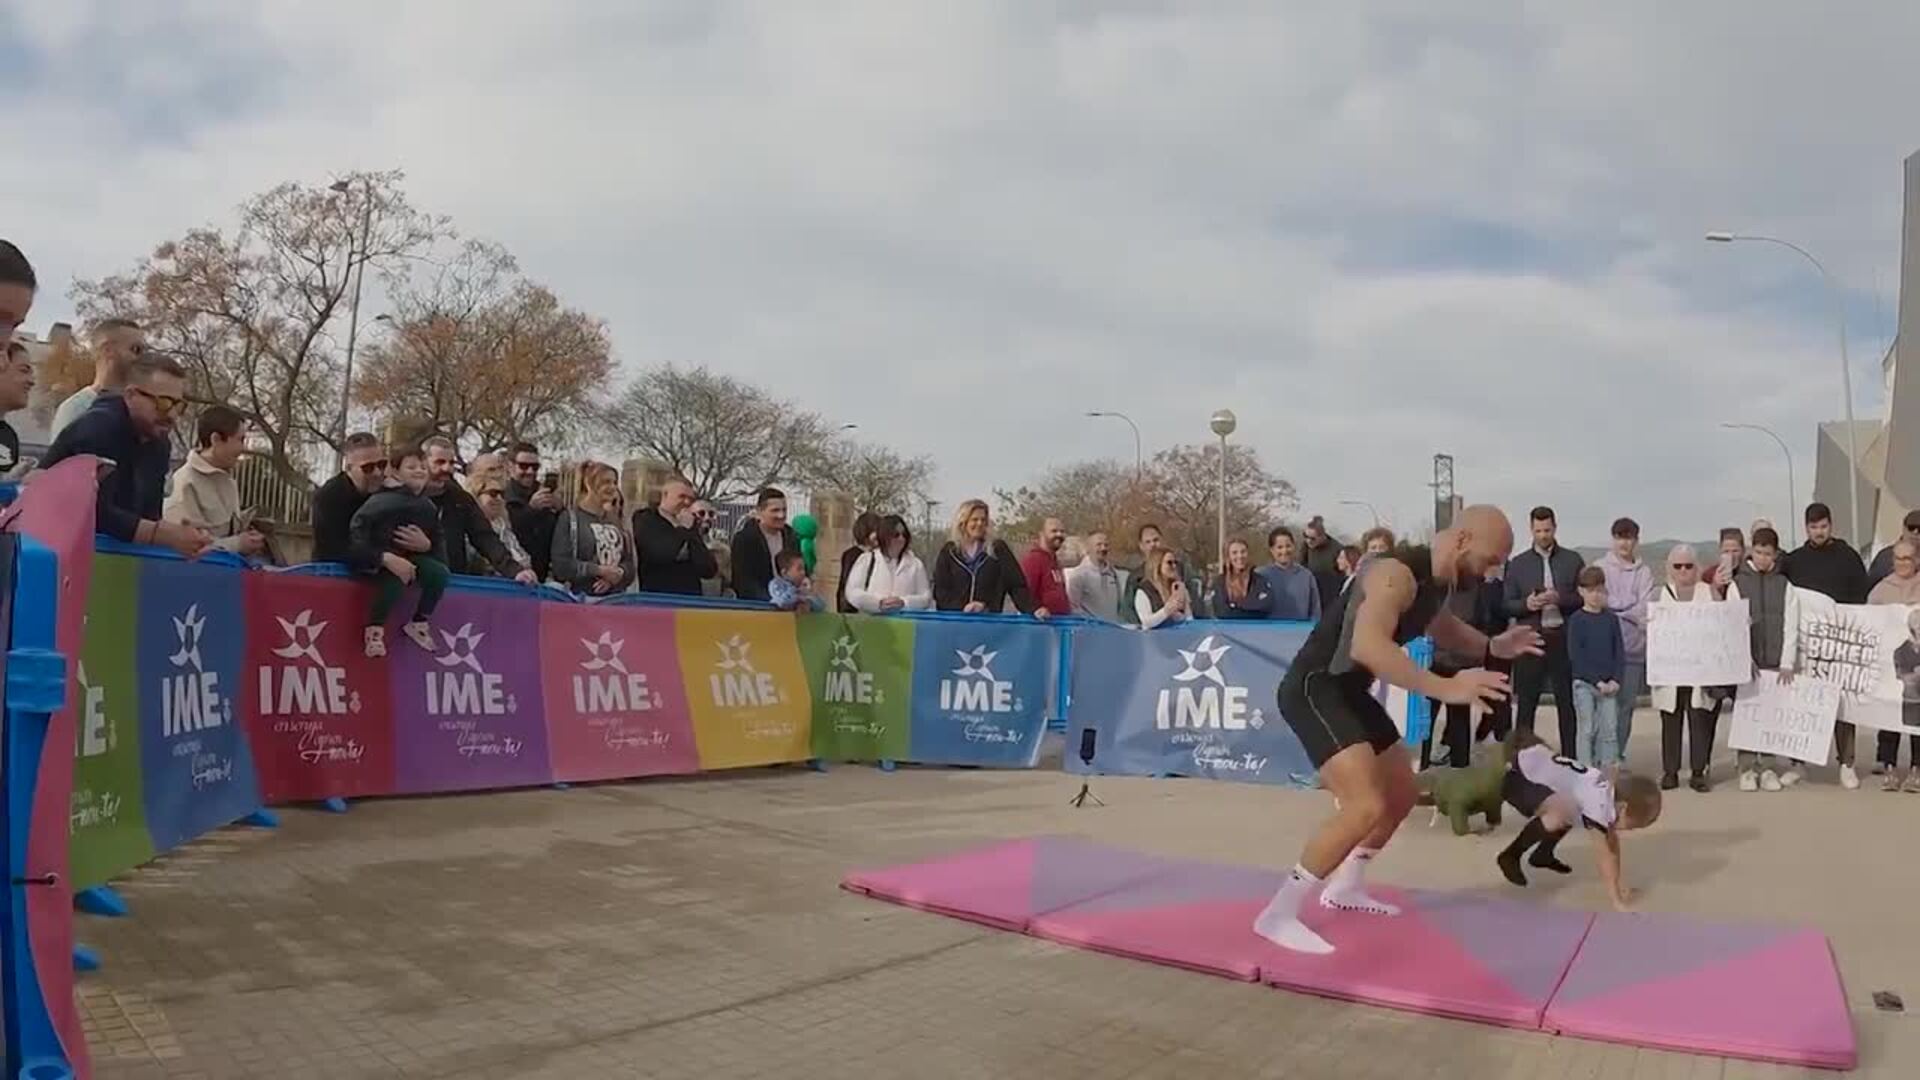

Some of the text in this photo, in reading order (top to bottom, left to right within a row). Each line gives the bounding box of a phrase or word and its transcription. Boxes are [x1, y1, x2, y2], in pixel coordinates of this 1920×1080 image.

[1808, 637, 1873, 666] BOXEO
[162, 671, 221, 737] IME
[259, 665, 347, 714] IME
[425, 672, 504, 714] IME
[573, 673, 651, 713] IME
[709, 672, 778, 706] IME
[825, 671, 873, 703] IME
[940, 679, 1012, 712] IME
[1157, 686, 1248, 730] IME
